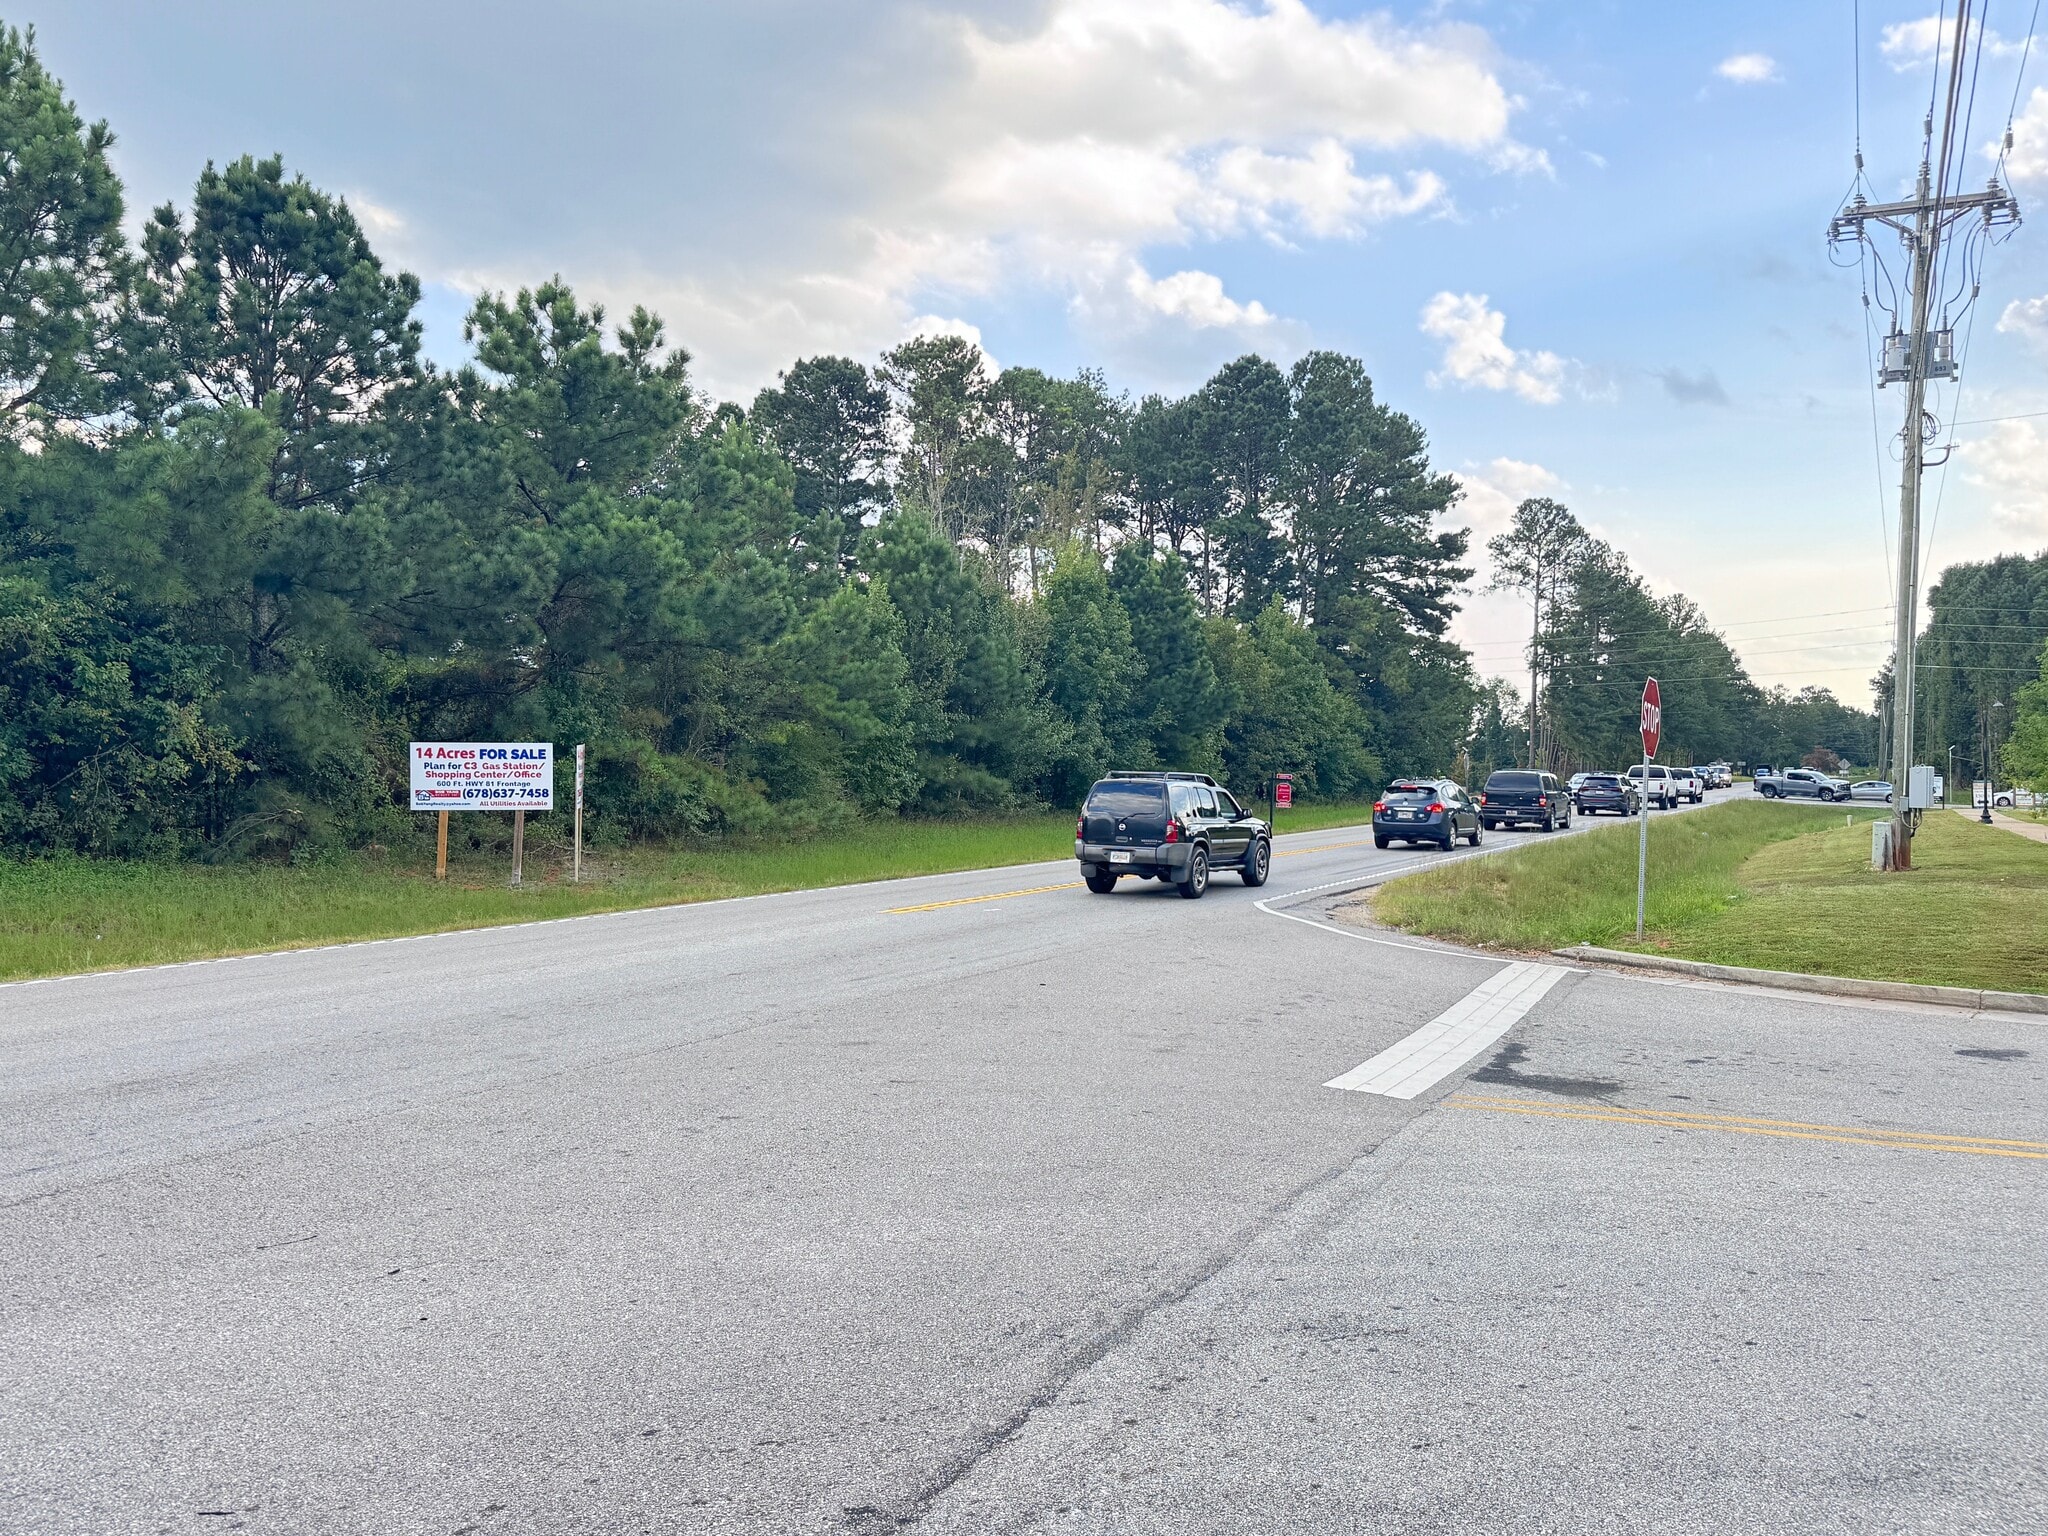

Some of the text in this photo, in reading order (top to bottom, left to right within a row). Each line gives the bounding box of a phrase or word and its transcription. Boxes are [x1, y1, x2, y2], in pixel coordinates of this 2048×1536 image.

[1642, 702, 1660, 734] STOP
[416, 747, 546, 760] 14 Acres FOR SALE
[425, 770, 542, 780] Shopping Center/Office
[462, 788, 549, 800] (678)637-7458
